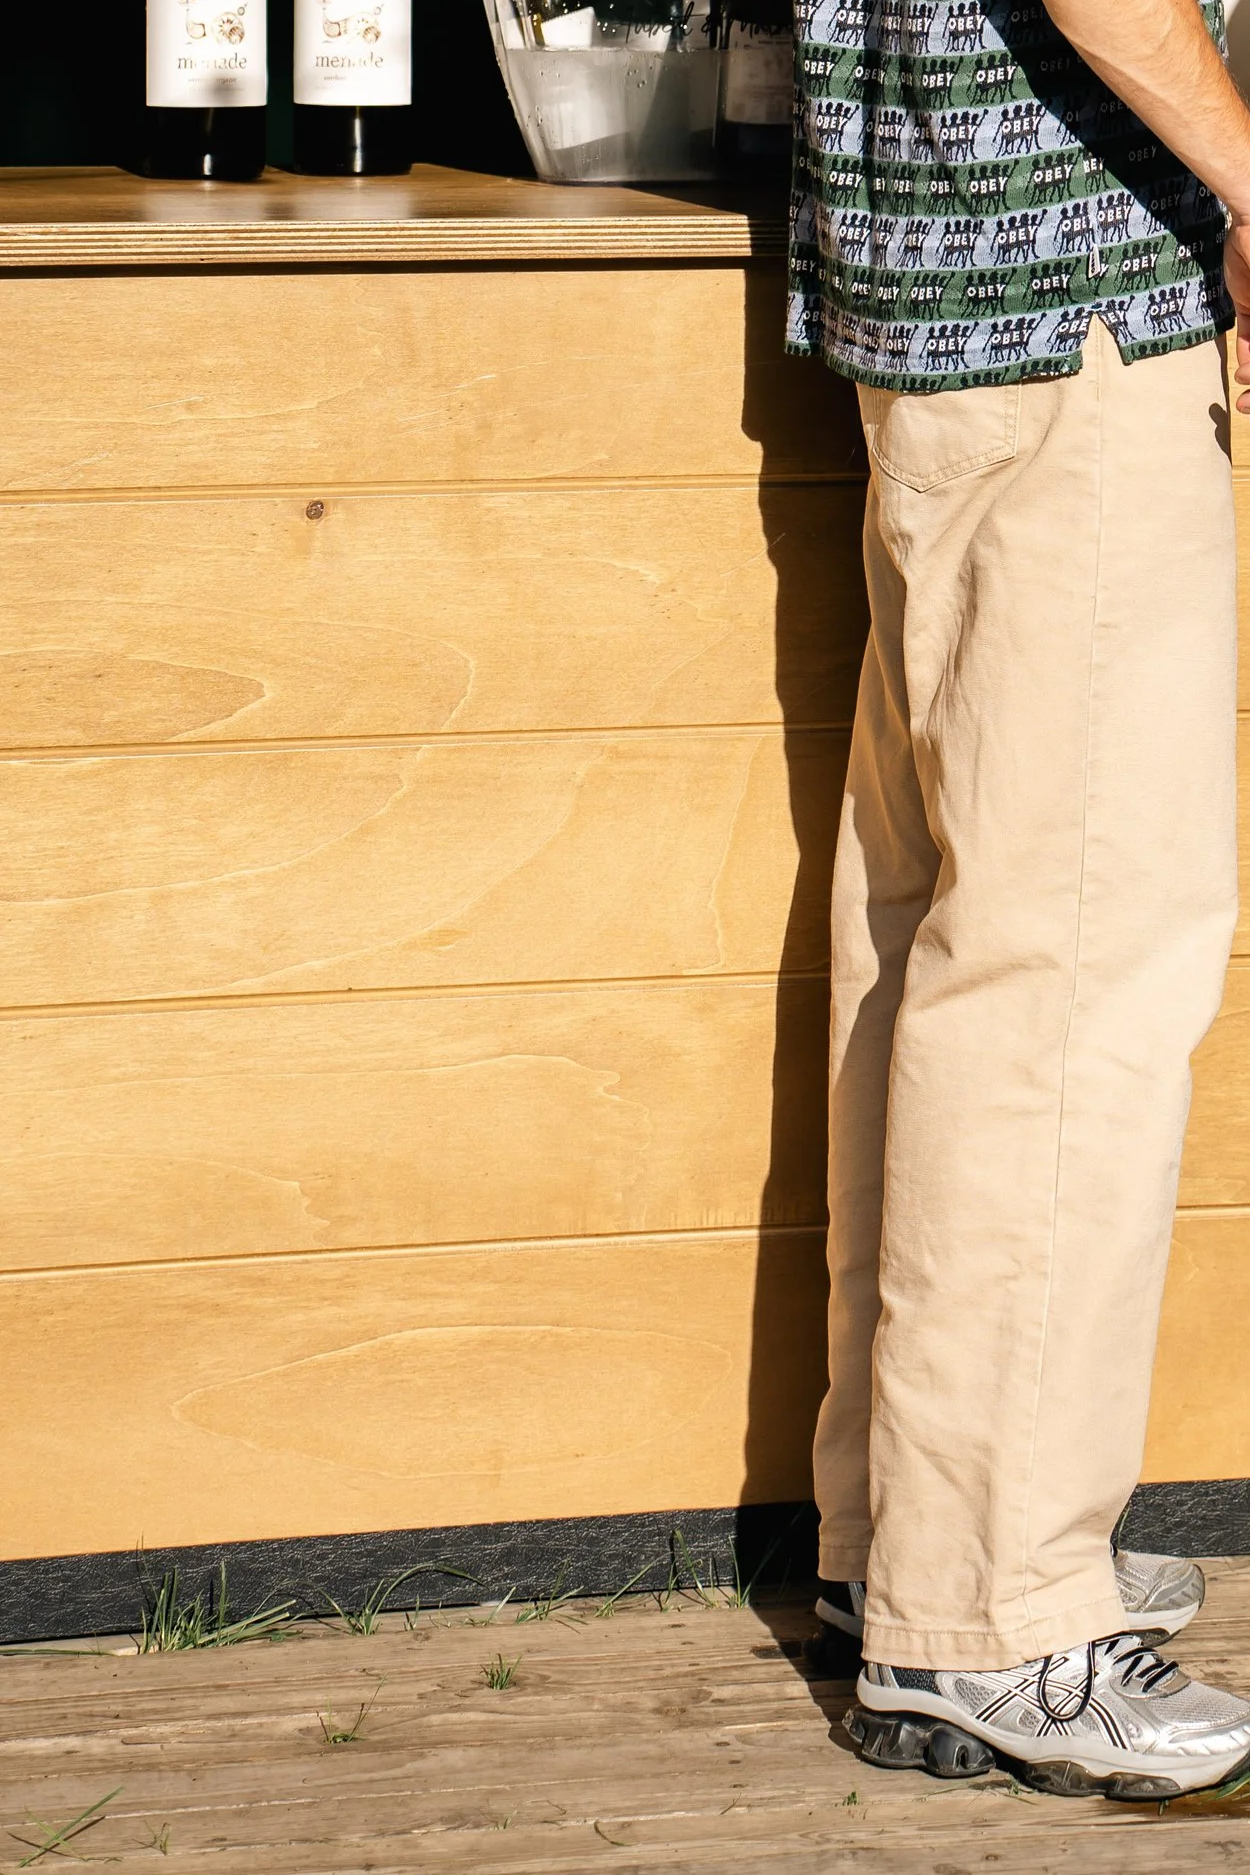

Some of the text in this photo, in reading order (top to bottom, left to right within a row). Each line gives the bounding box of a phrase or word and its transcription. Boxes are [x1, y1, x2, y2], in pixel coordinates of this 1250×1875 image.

[838, 8, 872, 25] OBEY
[949, 15, 986, 30] OBEY
[804, 60, 834, 76] OBEY
[976, 66, 1016, 83] OBEY
[923, 73, 954, 87] OBEY
[1100, 101, 1123, 113] OBE
[816, 115, 848, 129] OBEY
[1002, 118, 1040, 134] OBEY
[878, 125, 902, 137] OBEY
[942, 125, 978, 139] OBEY
[1128, 146, 1158, 161] OBEY
[1084, 158, 1103, 173] BEY
[829, 172, 862, 187] OBEY
[1034, 166, 1073, 183] OBEY
[970, 178, 1007, 194] OBEY
[1150, 194, 1181, 210] OBEY
[1098, 206, 1130, 222] OBEY
[839, 226, 871, 241] OBEY
[945, 234, 977, 247] OBEY
[998, 227, 1038, 244] OBEY
[1122, 255, 1158, 272] OBEY
[1032, 275, 1070, 290] OBEY
[910, 287, 943, 299] OBEY
[967, 284, 1006, 298] OBEY
[1151, 299, 1184, 315] OBEY
[1058, 319, 1087, 333] OBE
[927, 338, 966, 352] OBEY
[991, 330, 1031, 345] OBEY
